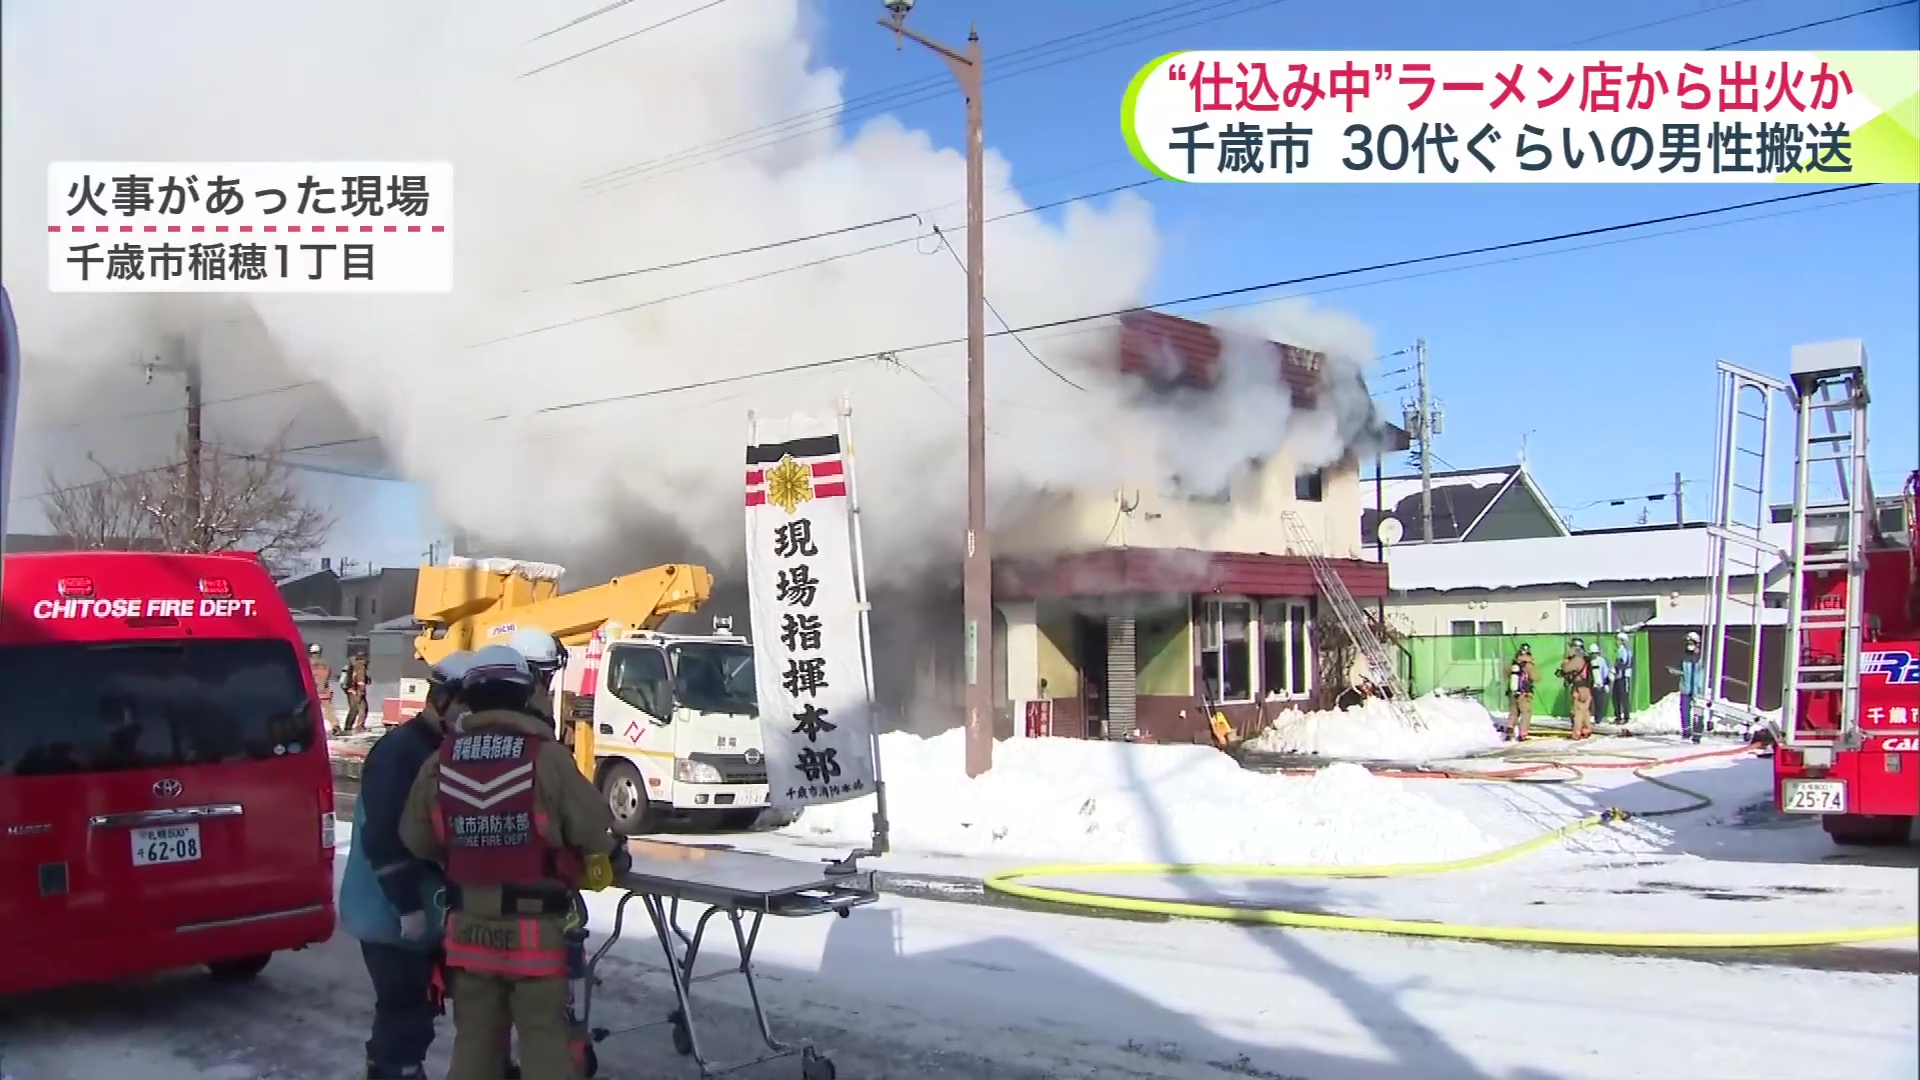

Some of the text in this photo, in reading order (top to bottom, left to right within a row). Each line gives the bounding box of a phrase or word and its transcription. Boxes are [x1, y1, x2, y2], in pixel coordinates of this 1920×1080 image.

[34, 600, 256, 618] CHITOSE FIRE DEPT.
[774, 518, 841, 784] 現場指揮本部
[148, 838, 197, 861] 62-08
